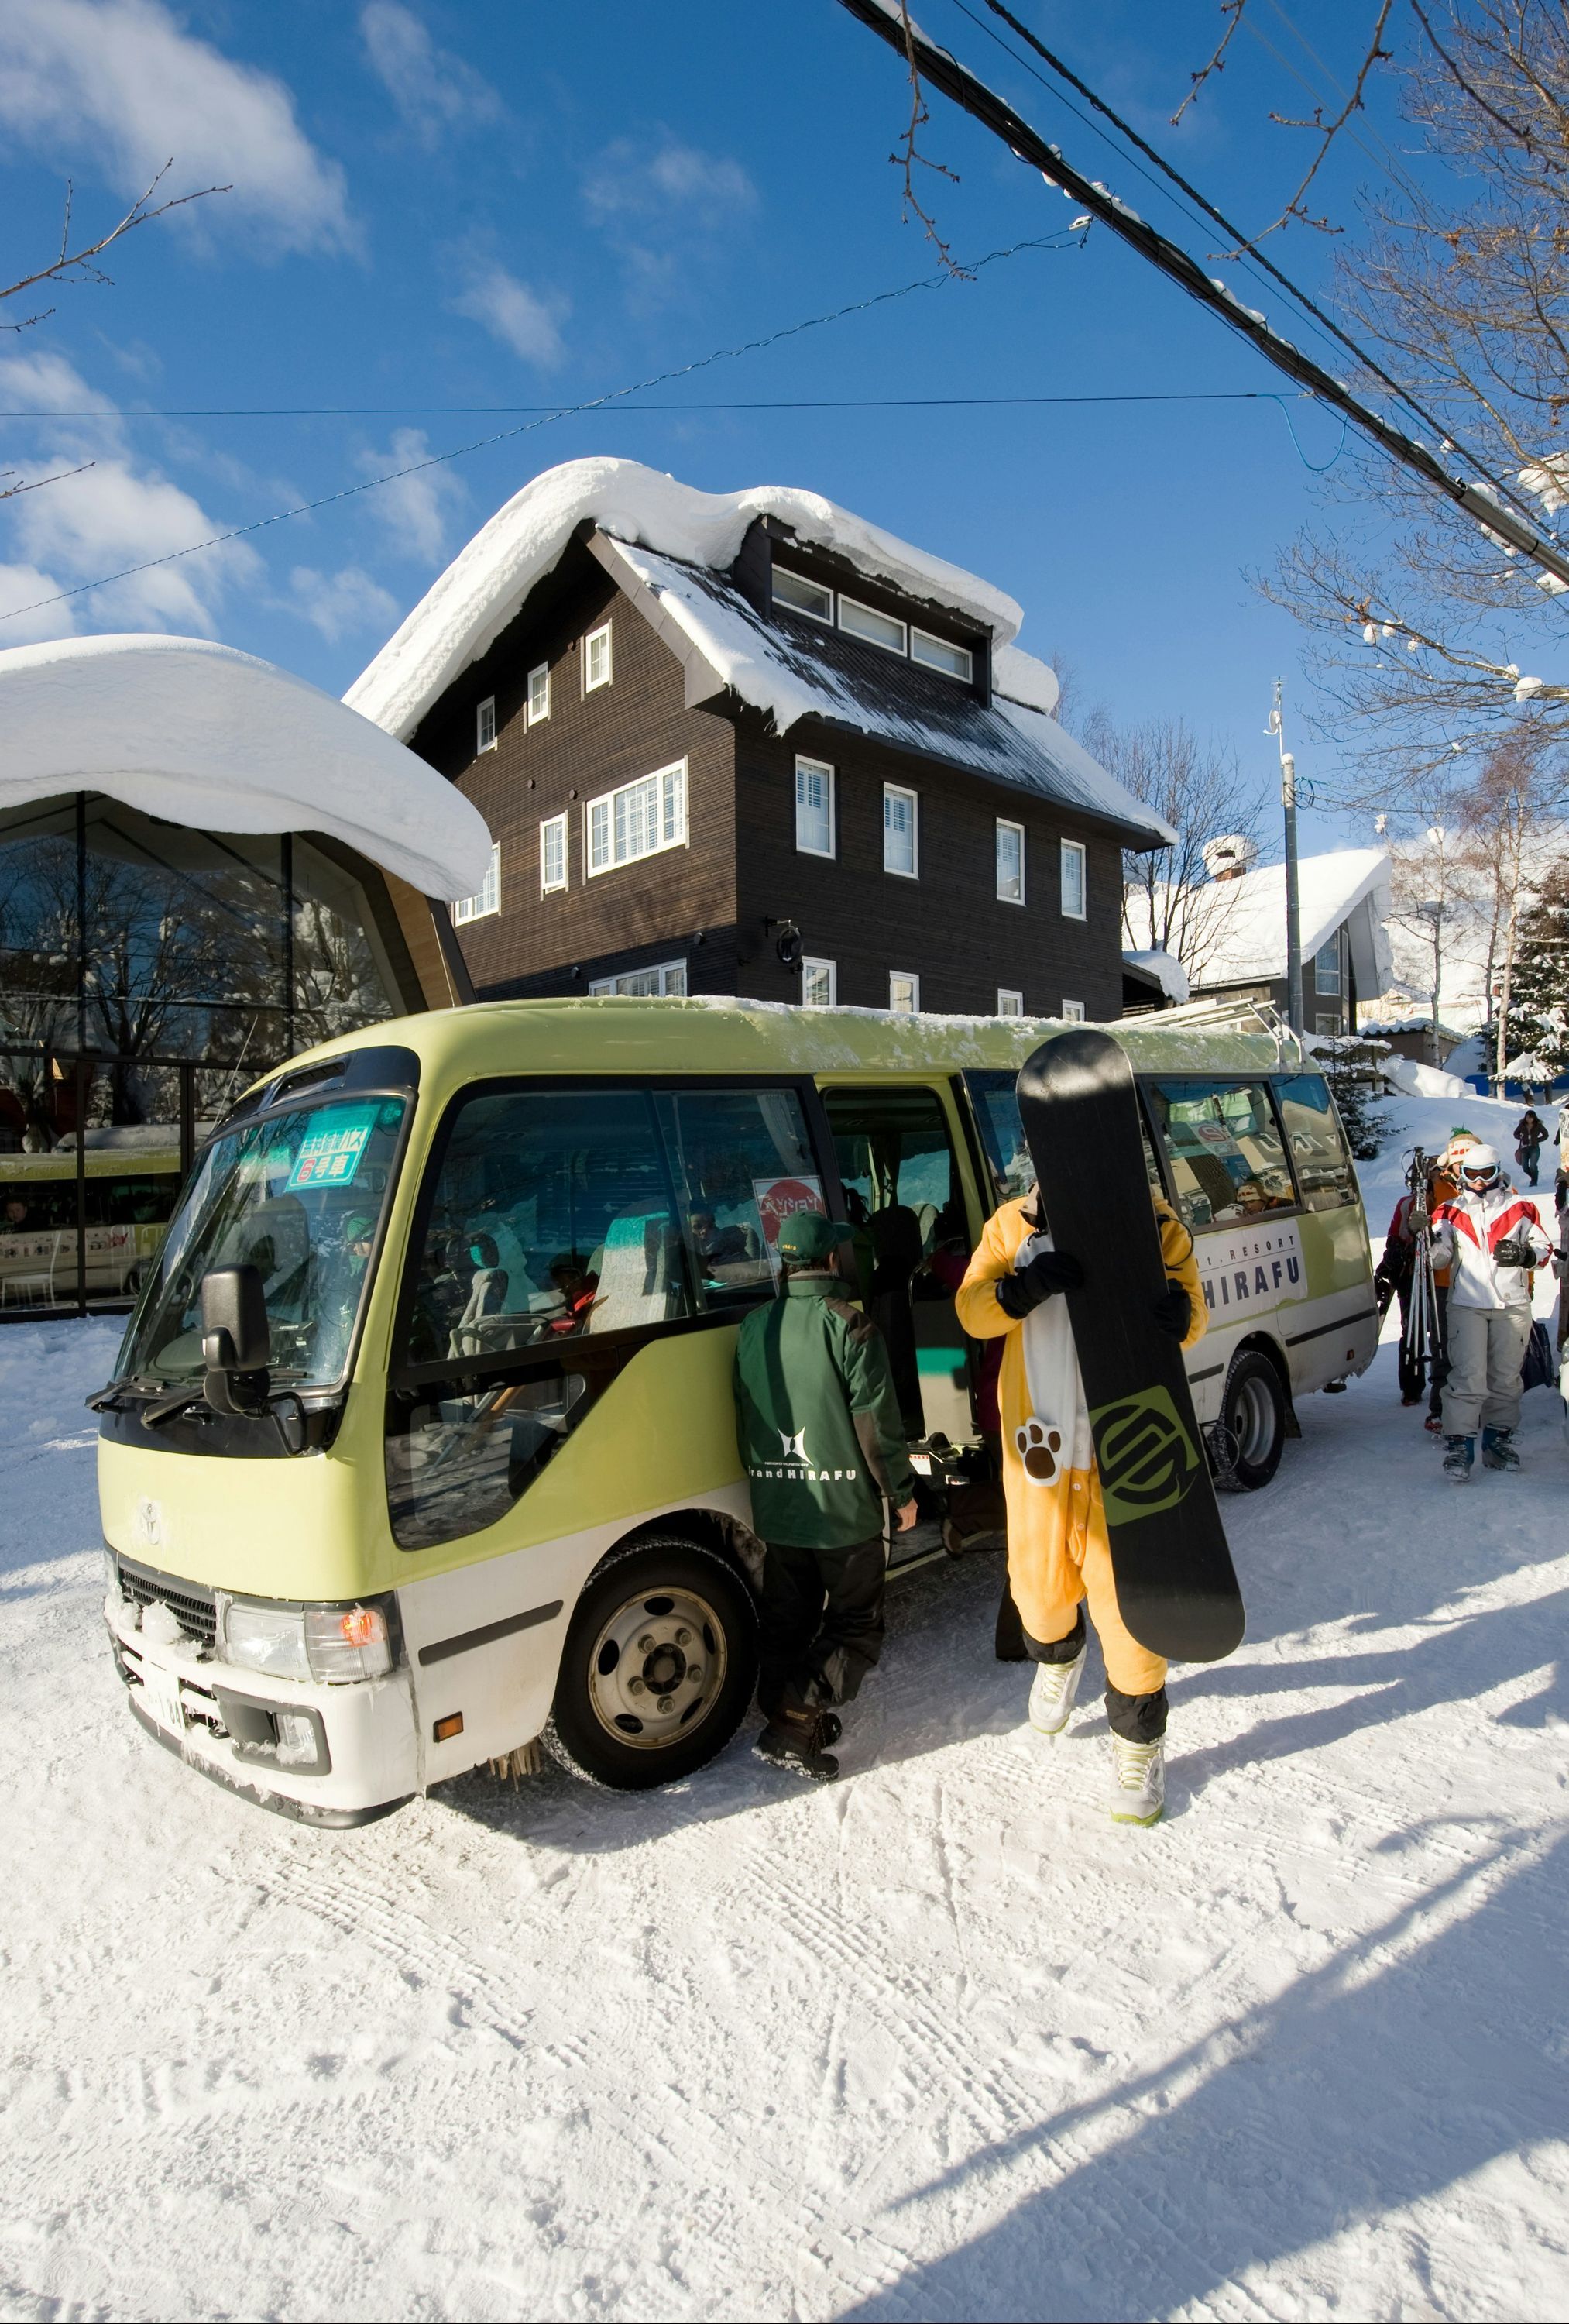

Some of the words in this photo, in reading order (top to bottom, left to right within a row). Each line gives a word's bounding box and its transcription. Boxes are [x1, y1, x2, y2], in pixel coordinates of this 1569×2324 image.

[297, 1154, 349, 1181] 6号車
[1196, 1235, 1295, 1268] t.RESORT
[1202, 1257, 1299, 1308] HIRAFU
[748, 1465, 783, 1478] rand
